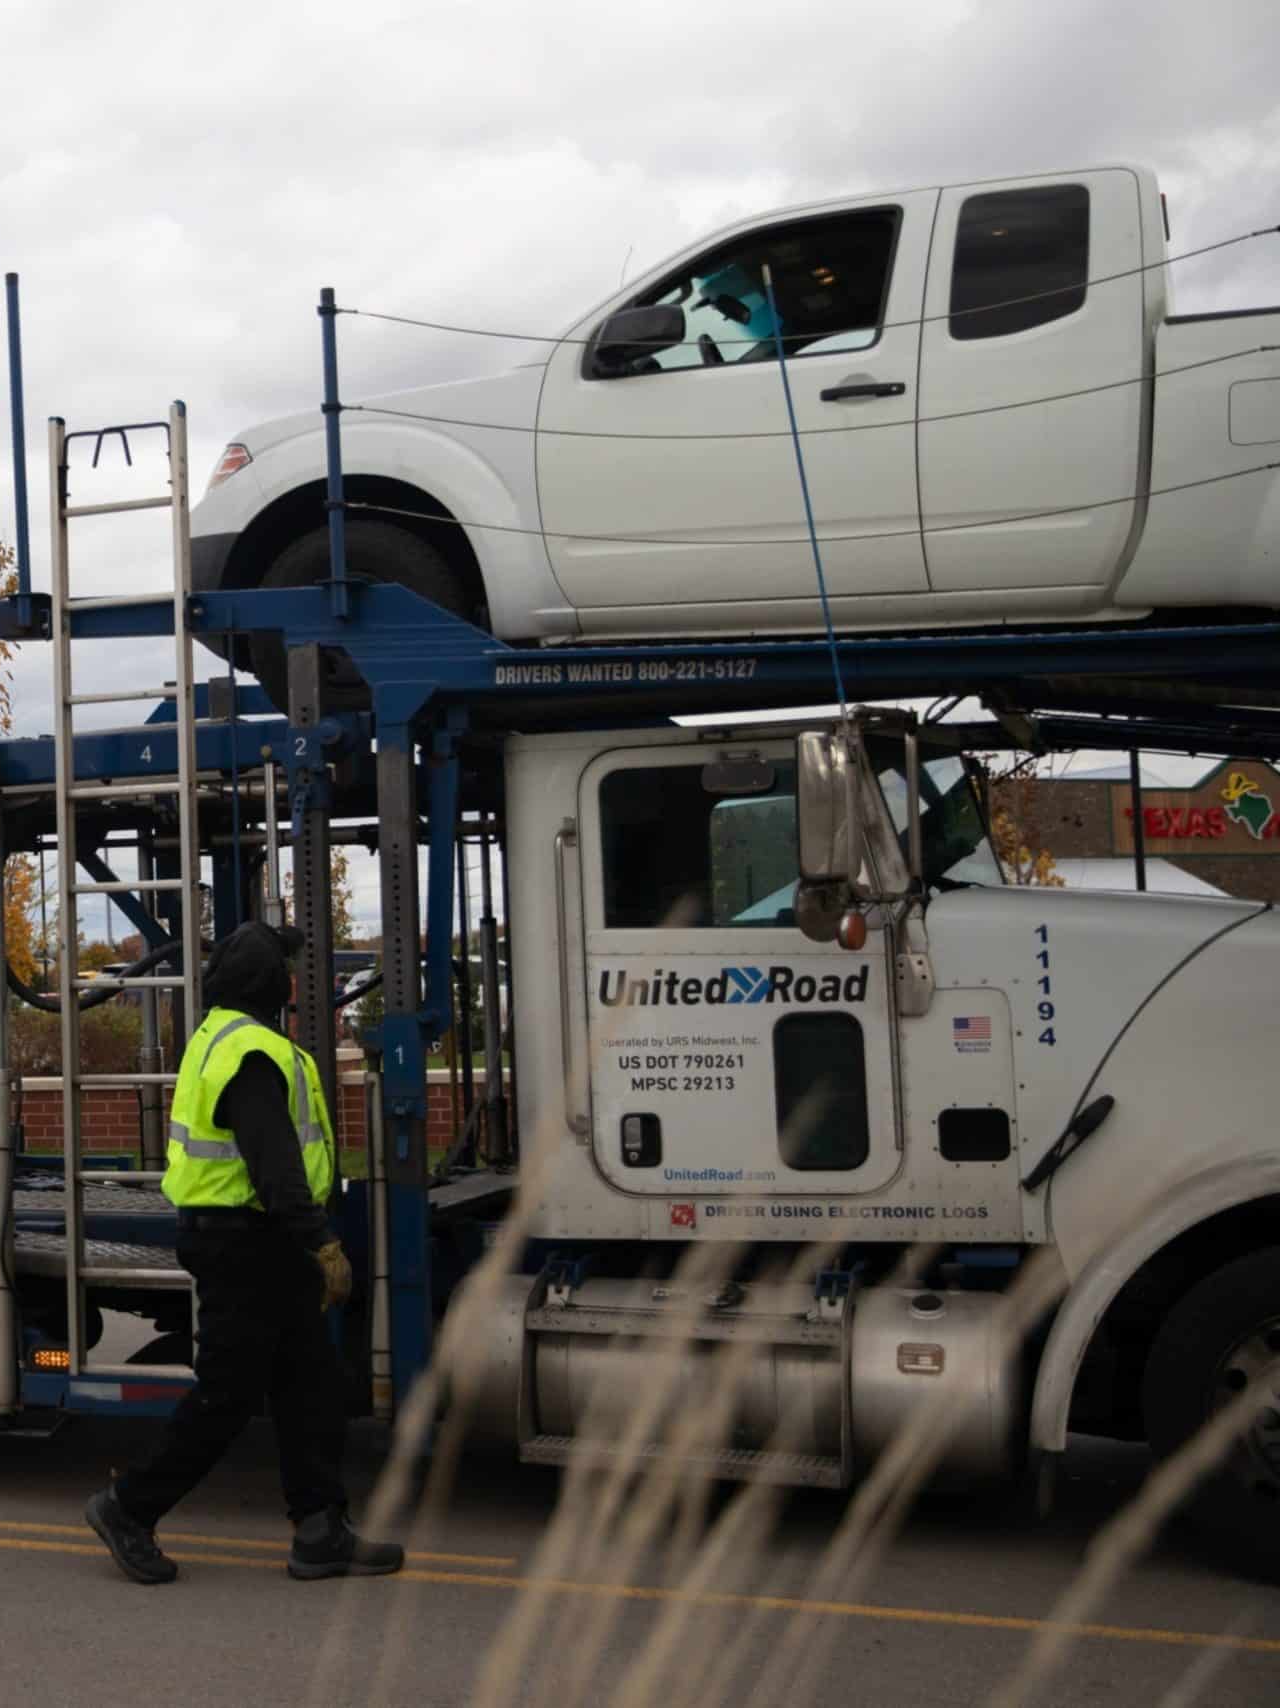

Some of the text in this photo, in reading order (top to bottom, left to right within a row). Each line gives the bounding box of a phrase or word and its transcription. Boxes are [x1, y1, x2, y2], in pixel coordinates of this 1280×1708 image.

[495, 659, 757, 685] DRIVERS WANTED 800-221-5127
[140, 745, 152, 763] 4
[295, 737, 307, 756] 2
[599, 964, 870, 1007] United Road
[1034, 923, 1057, 1047] 11194
[601, 1036, 649, 1049] Operated
[651, 1035, 663, 1048] by
[666, 1035, 689, 1046] URS
[742, 1034, 761, 1046] Inc.
[394, 1044, 404, 1065] 1
[618, 1053, 745, 1070] US DOT 790261
[631, 1076, 735, 1091] MPSC 29213
[663, 1168, 776, 1182] UnitedRoadcom
[705, 1205, 989, 1219] DRIVER USING ELECTRONIC LOGS
